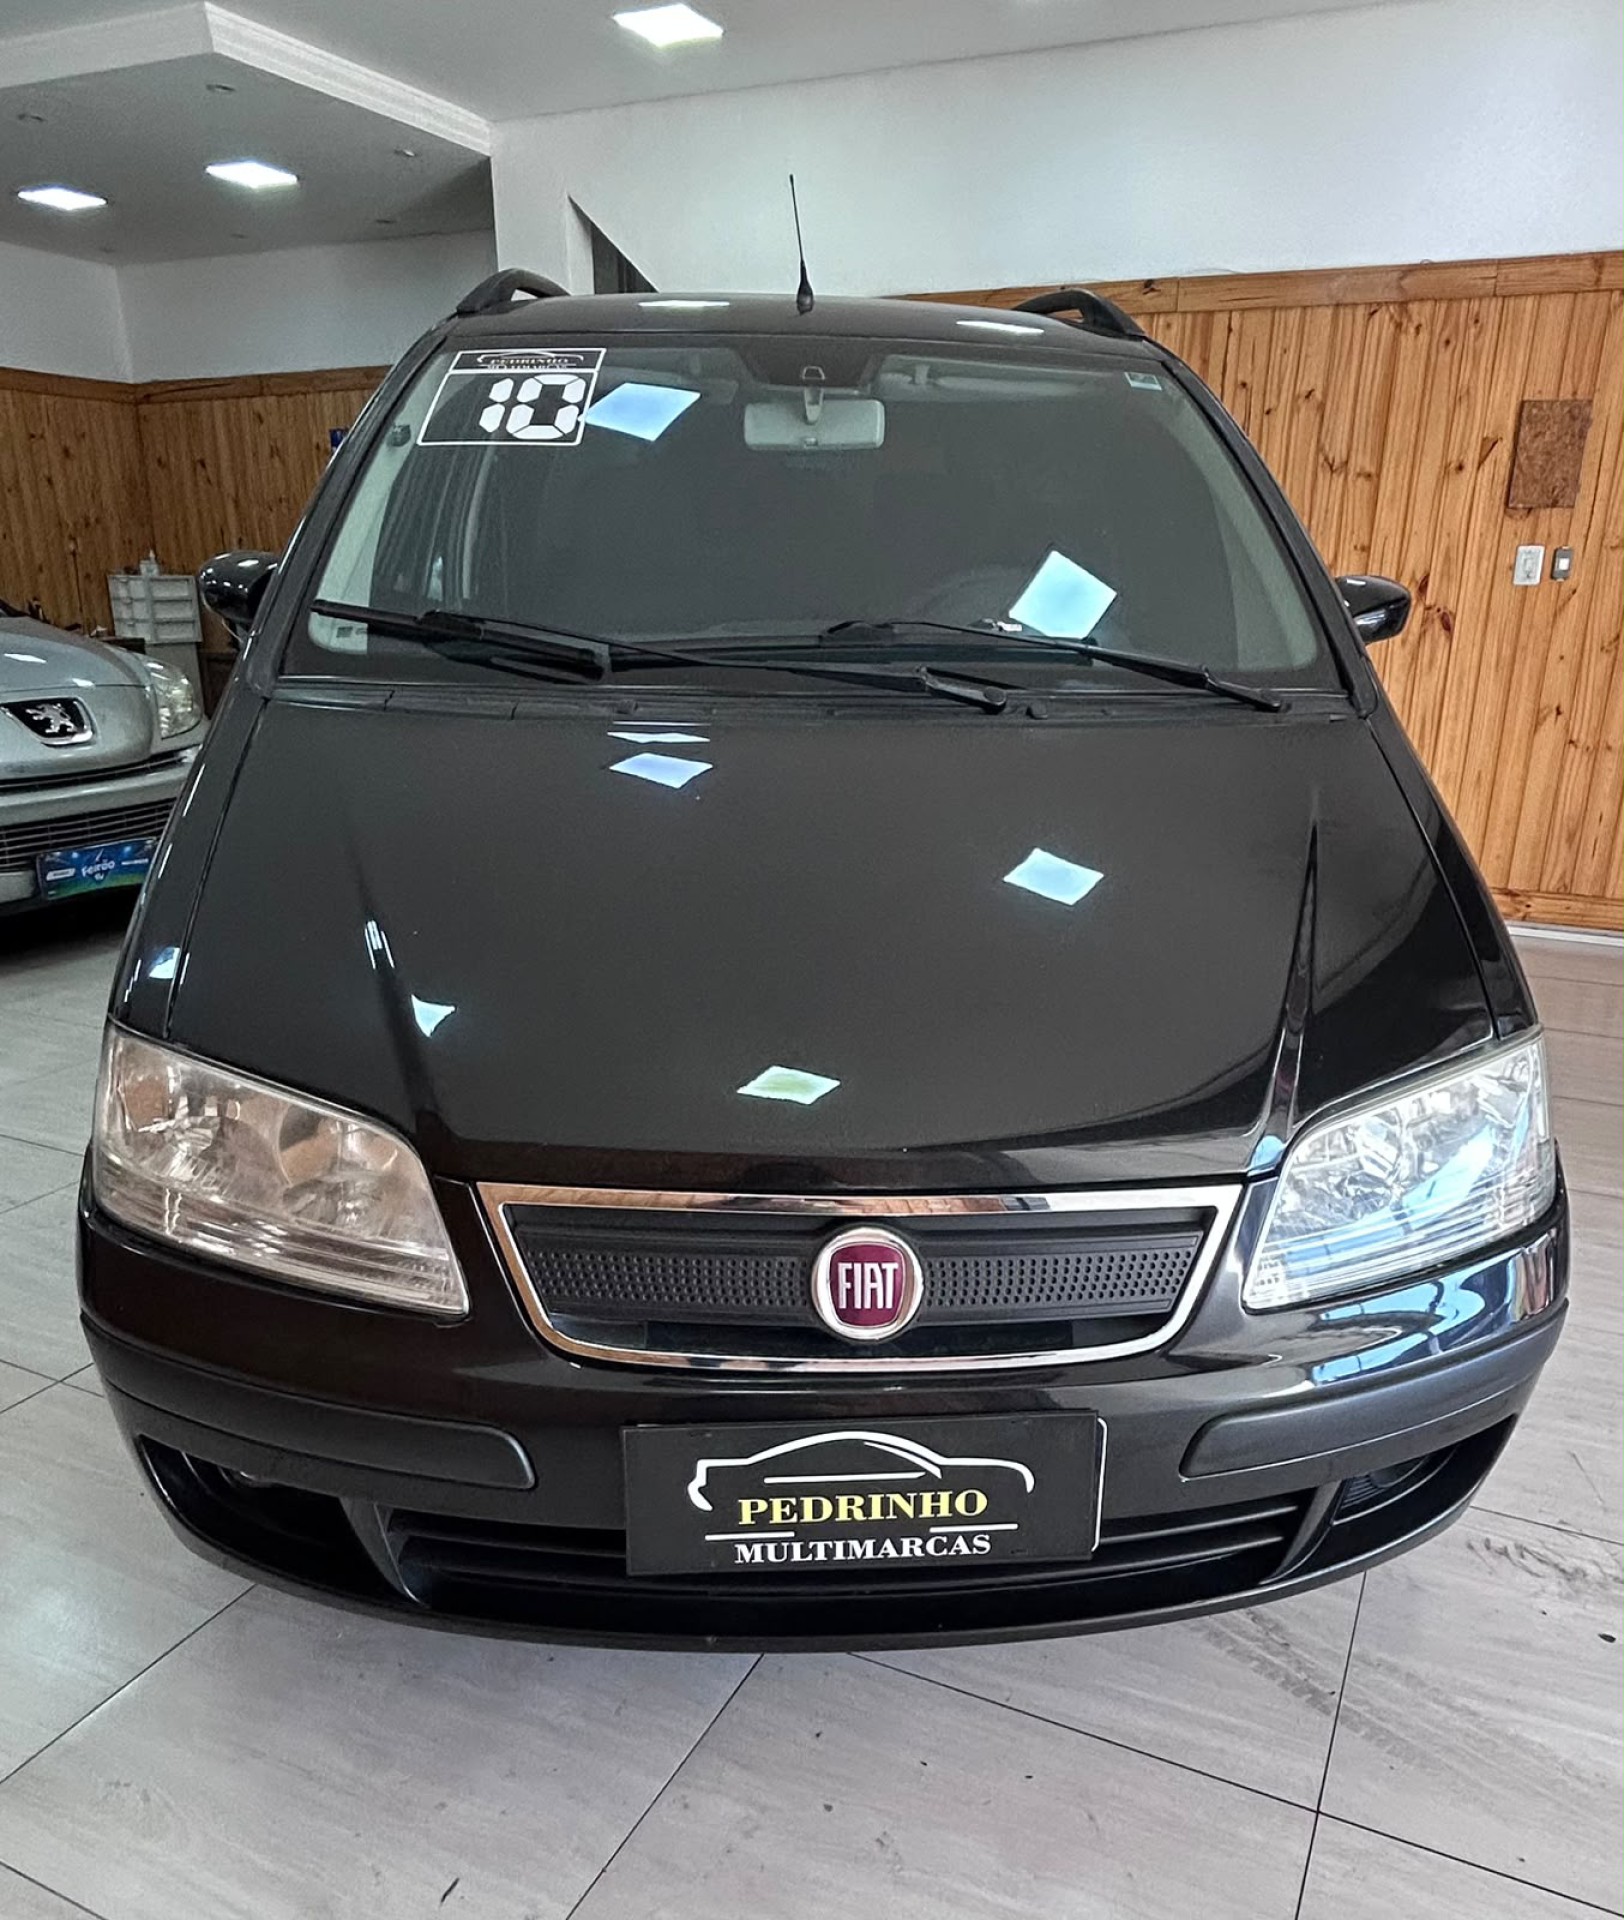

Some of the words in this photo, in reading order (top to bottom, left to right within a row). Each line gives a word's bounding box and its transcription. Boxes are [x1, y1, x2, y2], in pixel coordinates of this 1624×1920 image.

[478, 374, 587, 440] 10
[837, 1262, 899, 1309] FIAT
[737, 1488, 989, 1525] PEDRINHO
[733, 1533, 992, 1564] MULTIMARCAS
